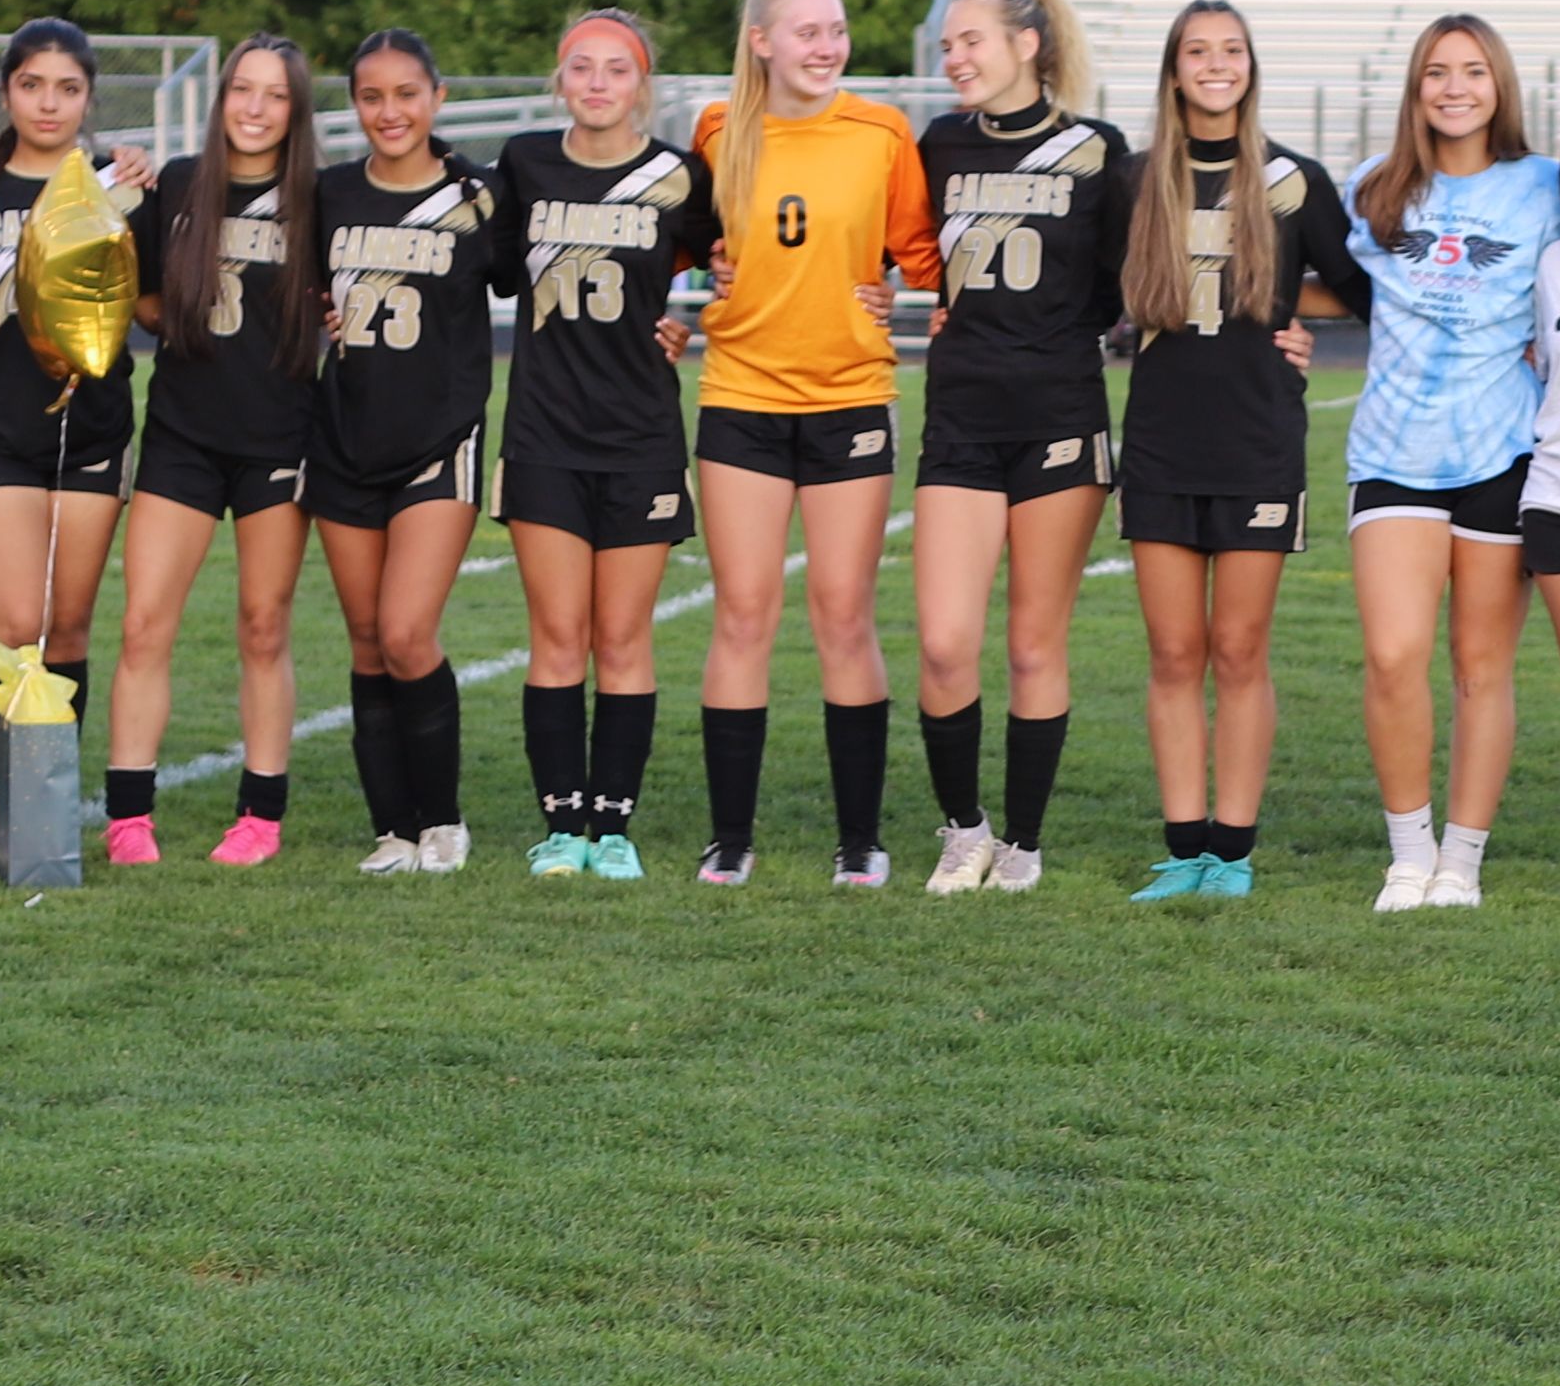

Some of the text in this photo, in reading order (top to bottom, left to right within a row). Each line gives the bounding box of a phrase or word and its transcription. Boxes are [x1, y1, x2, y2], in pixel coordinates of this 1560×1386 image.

[943, 173, 1074, 218] CANNERS
[328, 225, 456, 276] CANNERS
[527, 199, 660, 251] CANNERS
[1432, 234, 1463, 266] 5
[960, 226, 1043, 291] 20
[342, 282, 423, 350] 23
[549, 258, 625, 323] 13
